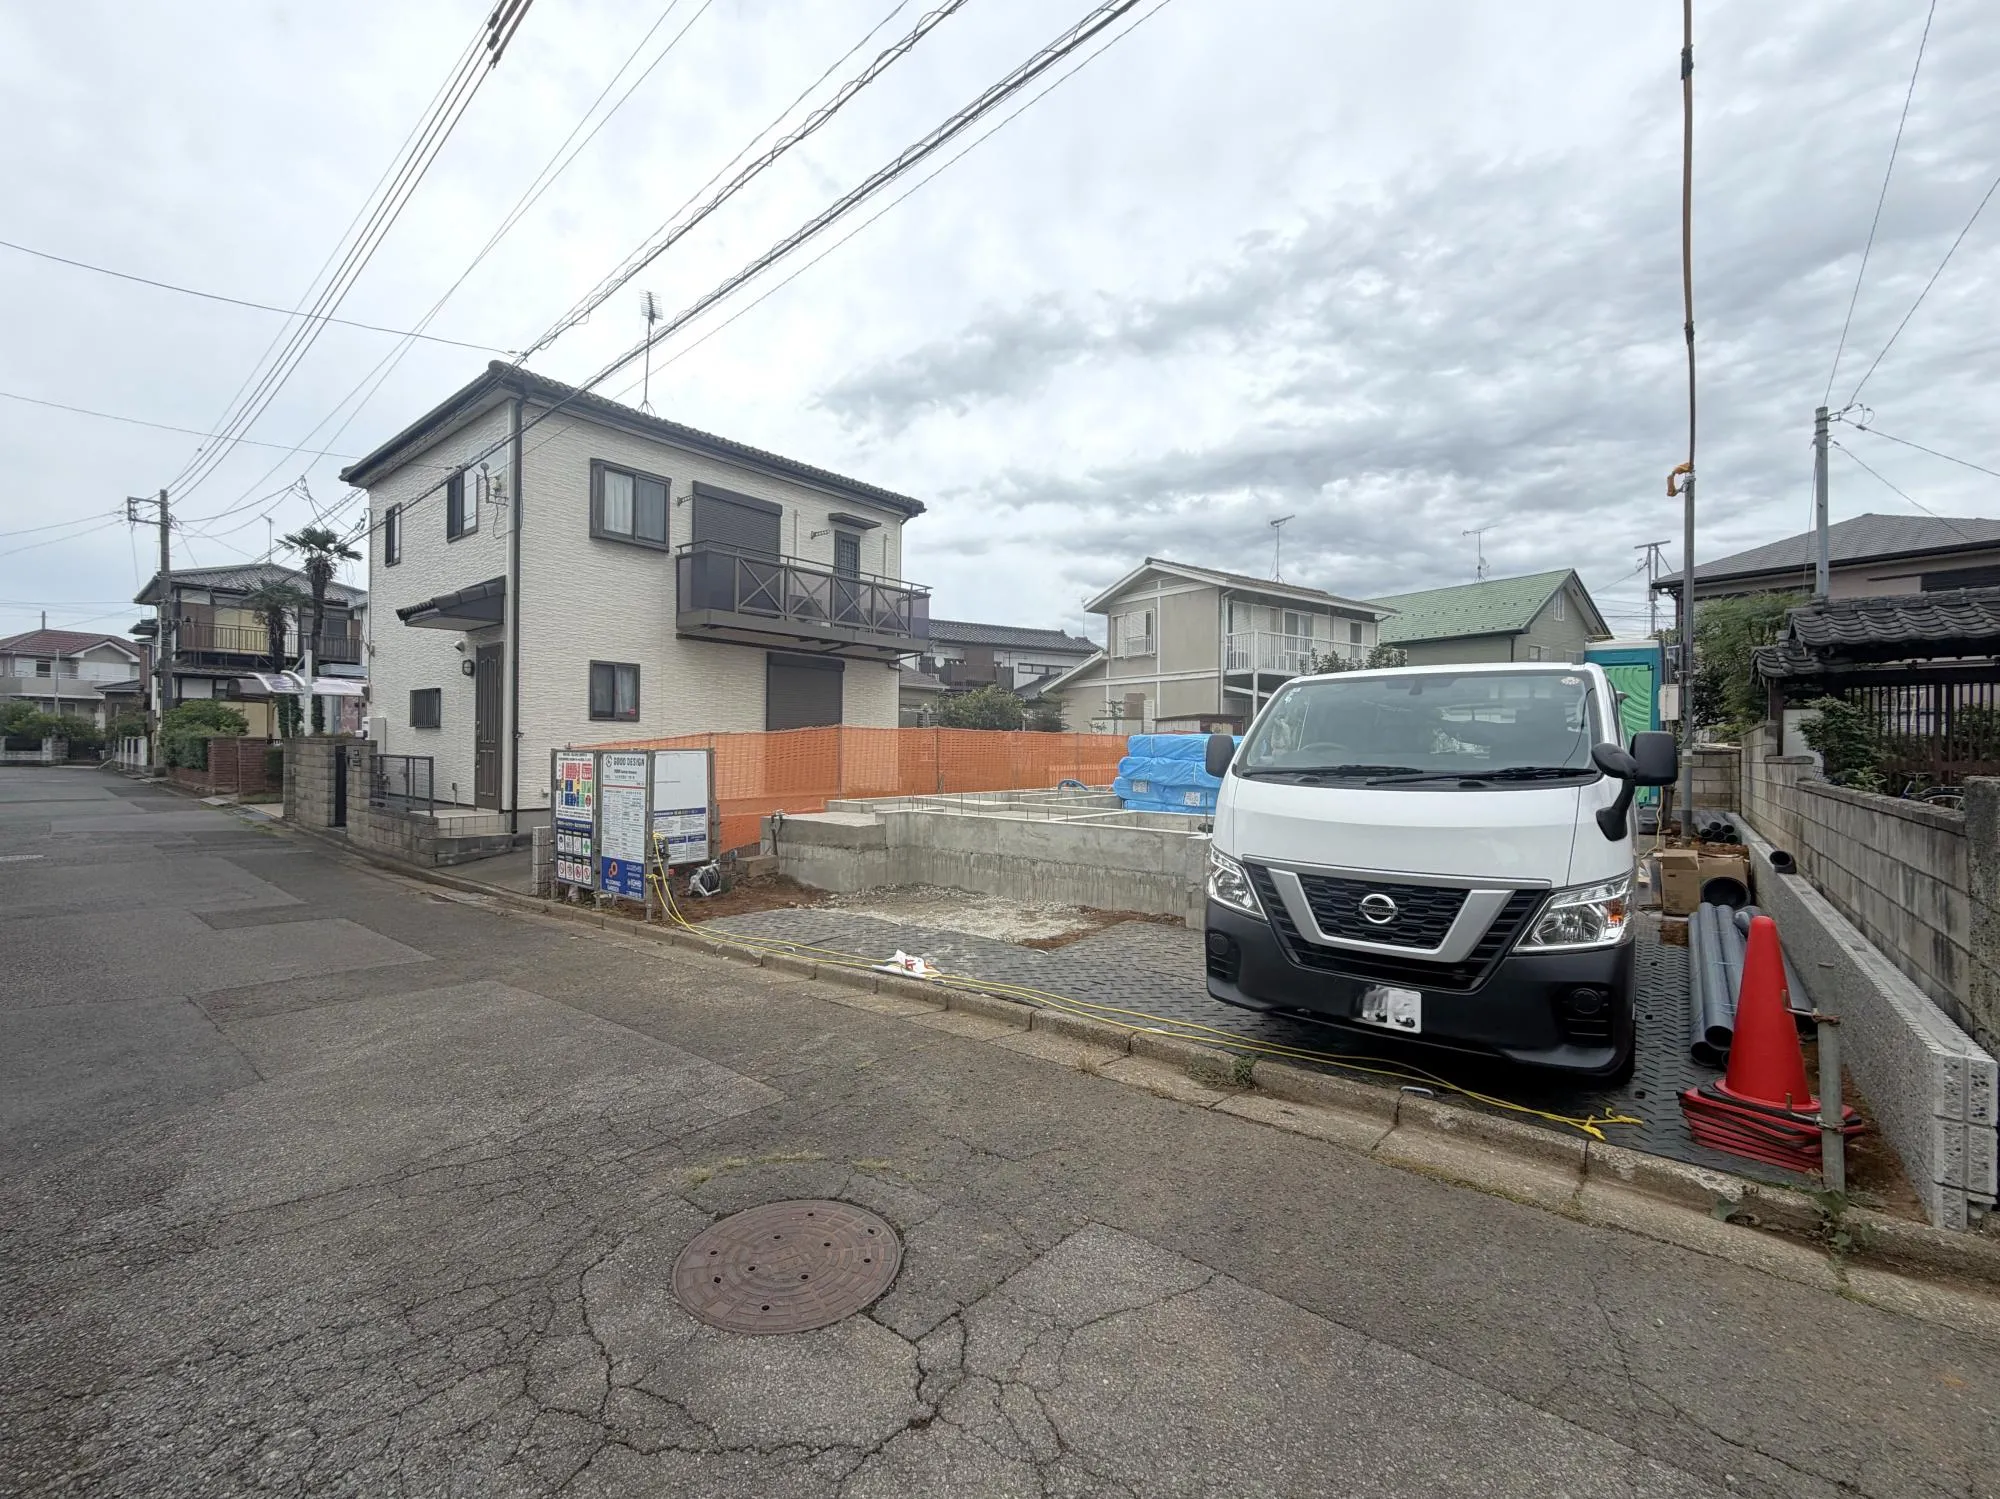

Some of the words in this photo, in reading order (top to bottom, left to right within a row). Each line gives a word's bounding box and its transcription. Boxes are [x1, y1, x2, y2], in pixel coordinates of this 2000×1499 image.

[613, 757, 626, 766] GOOD
[627, 757, 645, 767] DESIGN
[1362, 905, 1394, 914] NISSAN
